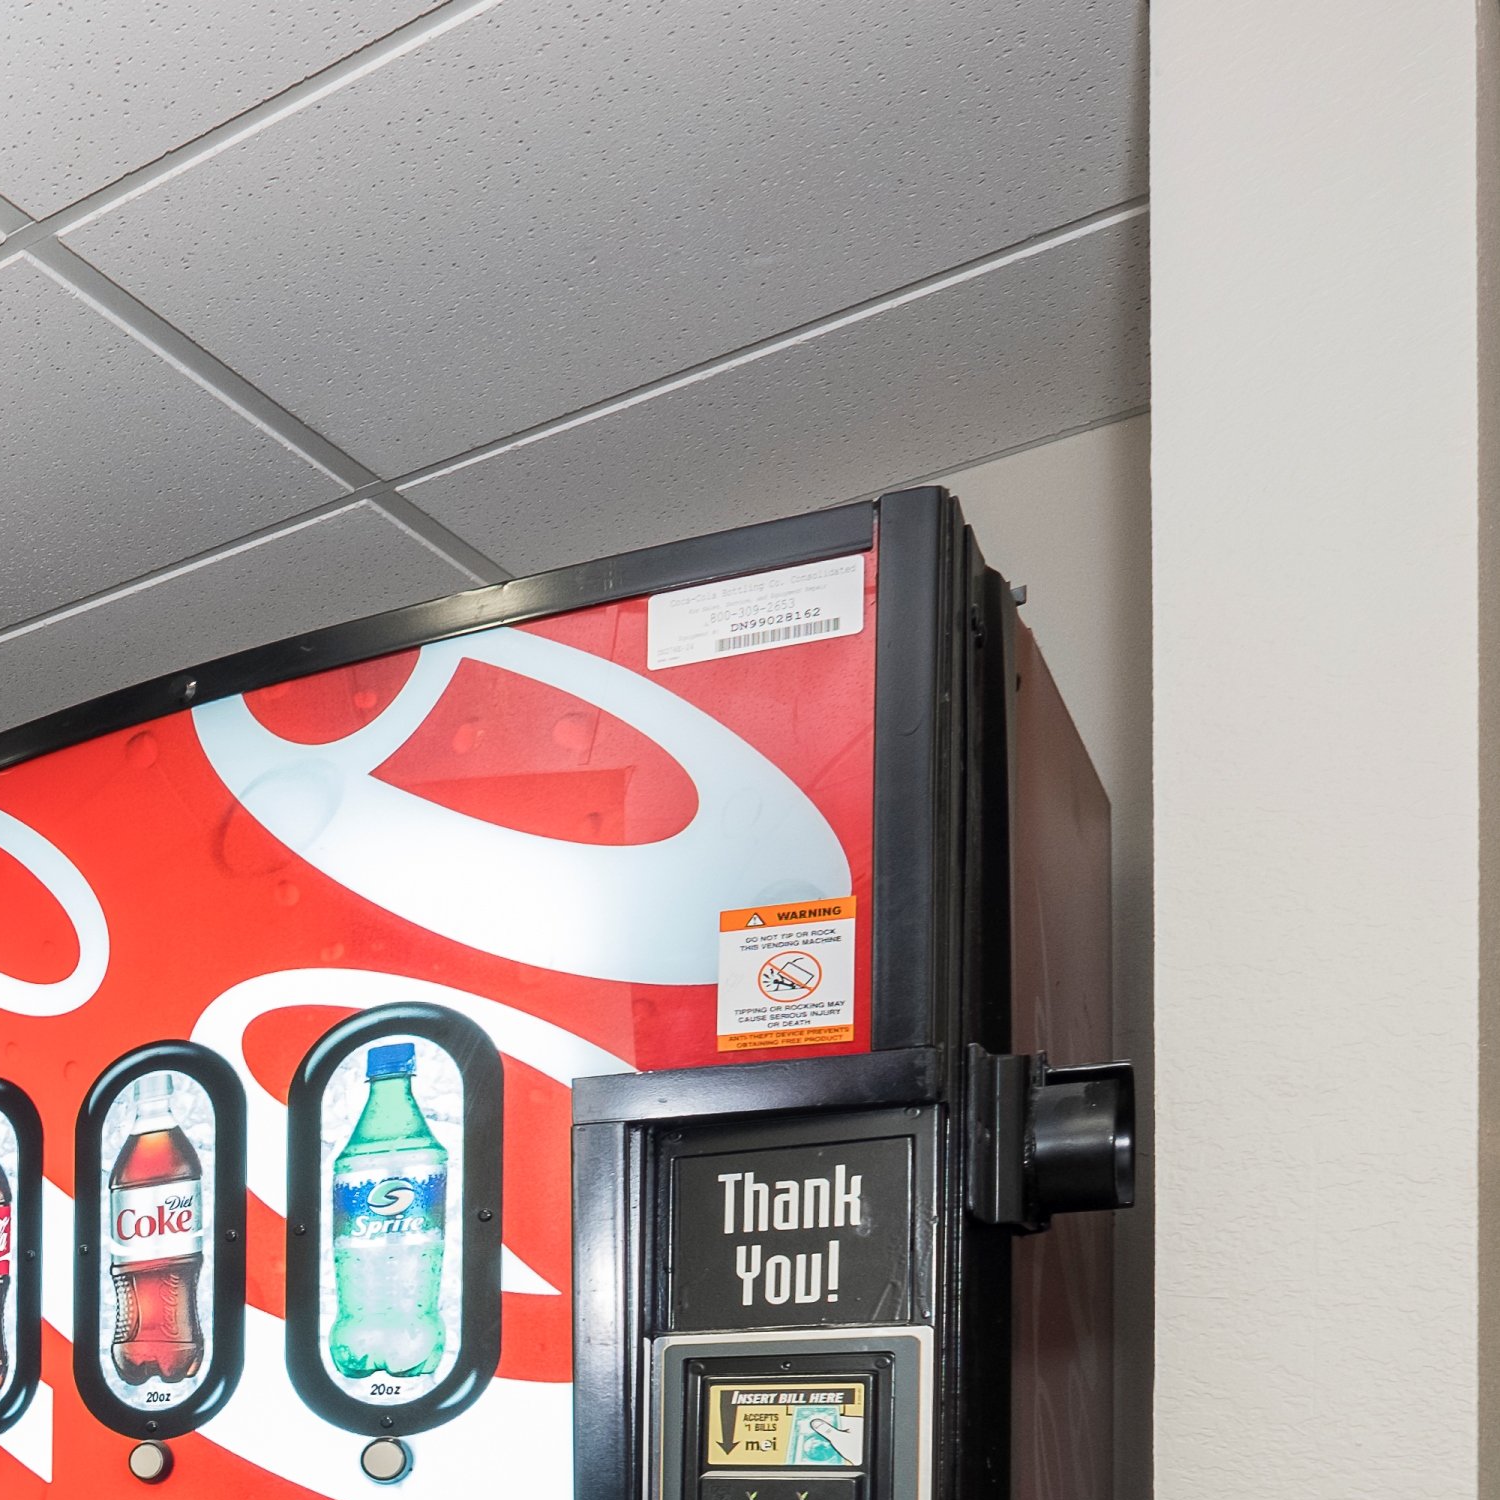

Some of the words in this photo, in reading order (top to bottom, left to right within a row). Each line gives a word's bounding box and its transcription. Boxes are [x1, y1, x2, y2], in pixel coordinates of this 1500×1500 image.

[730, 607, 821, 632] DN99028162
[777, 905, 842, 922] WARNING
[740, 944, 759, 952] THIS
[762, 940, 799, 950] VENDING
[802, 935, 842, 946] MACHINE
[745, 936, 758, 944] DO
[761, 934, 778, 942] NOT
[781, 932, 795, 940] TIP
[796, 930, 809, 939] OR
[811, 928, 836, 937] ROCK
[735, 1006, 767, 1016] TIPPING
[770, 1004, 782, 1012] OR
[785, 1002, 824, 1011] ROCKING
[828, 1000, 845, 1008] MAY
[738, 1014, 767, 1023] CAUSE
[770, 1011, 807, 1021] SERIOUS
[810, 1008, 840, 1017] INJURY
[767, 1020, 780, 1028] OR
[782, 1018, 811, 1027] DEATH
[165, 1193, 193, 1211] Diet
[718, 1164, 862, 1234] Thank
[116, 1206, 193, 1242] Coke
[351, 1213, 425, 1237] Sprite
[736, 1240, 839, 1306] You!
[146, 1391, 171, 1404] 20oz
[370, 1384, 401, 1396] 20oz
[731, 1391, 777, 1405] INSERT
[778, 1392, 807, 1404] BILL
[809, 1391, 845, 1404] HERE
[743, 1413, 779, 1422] ACCEPTS
[755, 1423, 777, 1432] BILLS
[745, 1437, 777, 1452] mei
